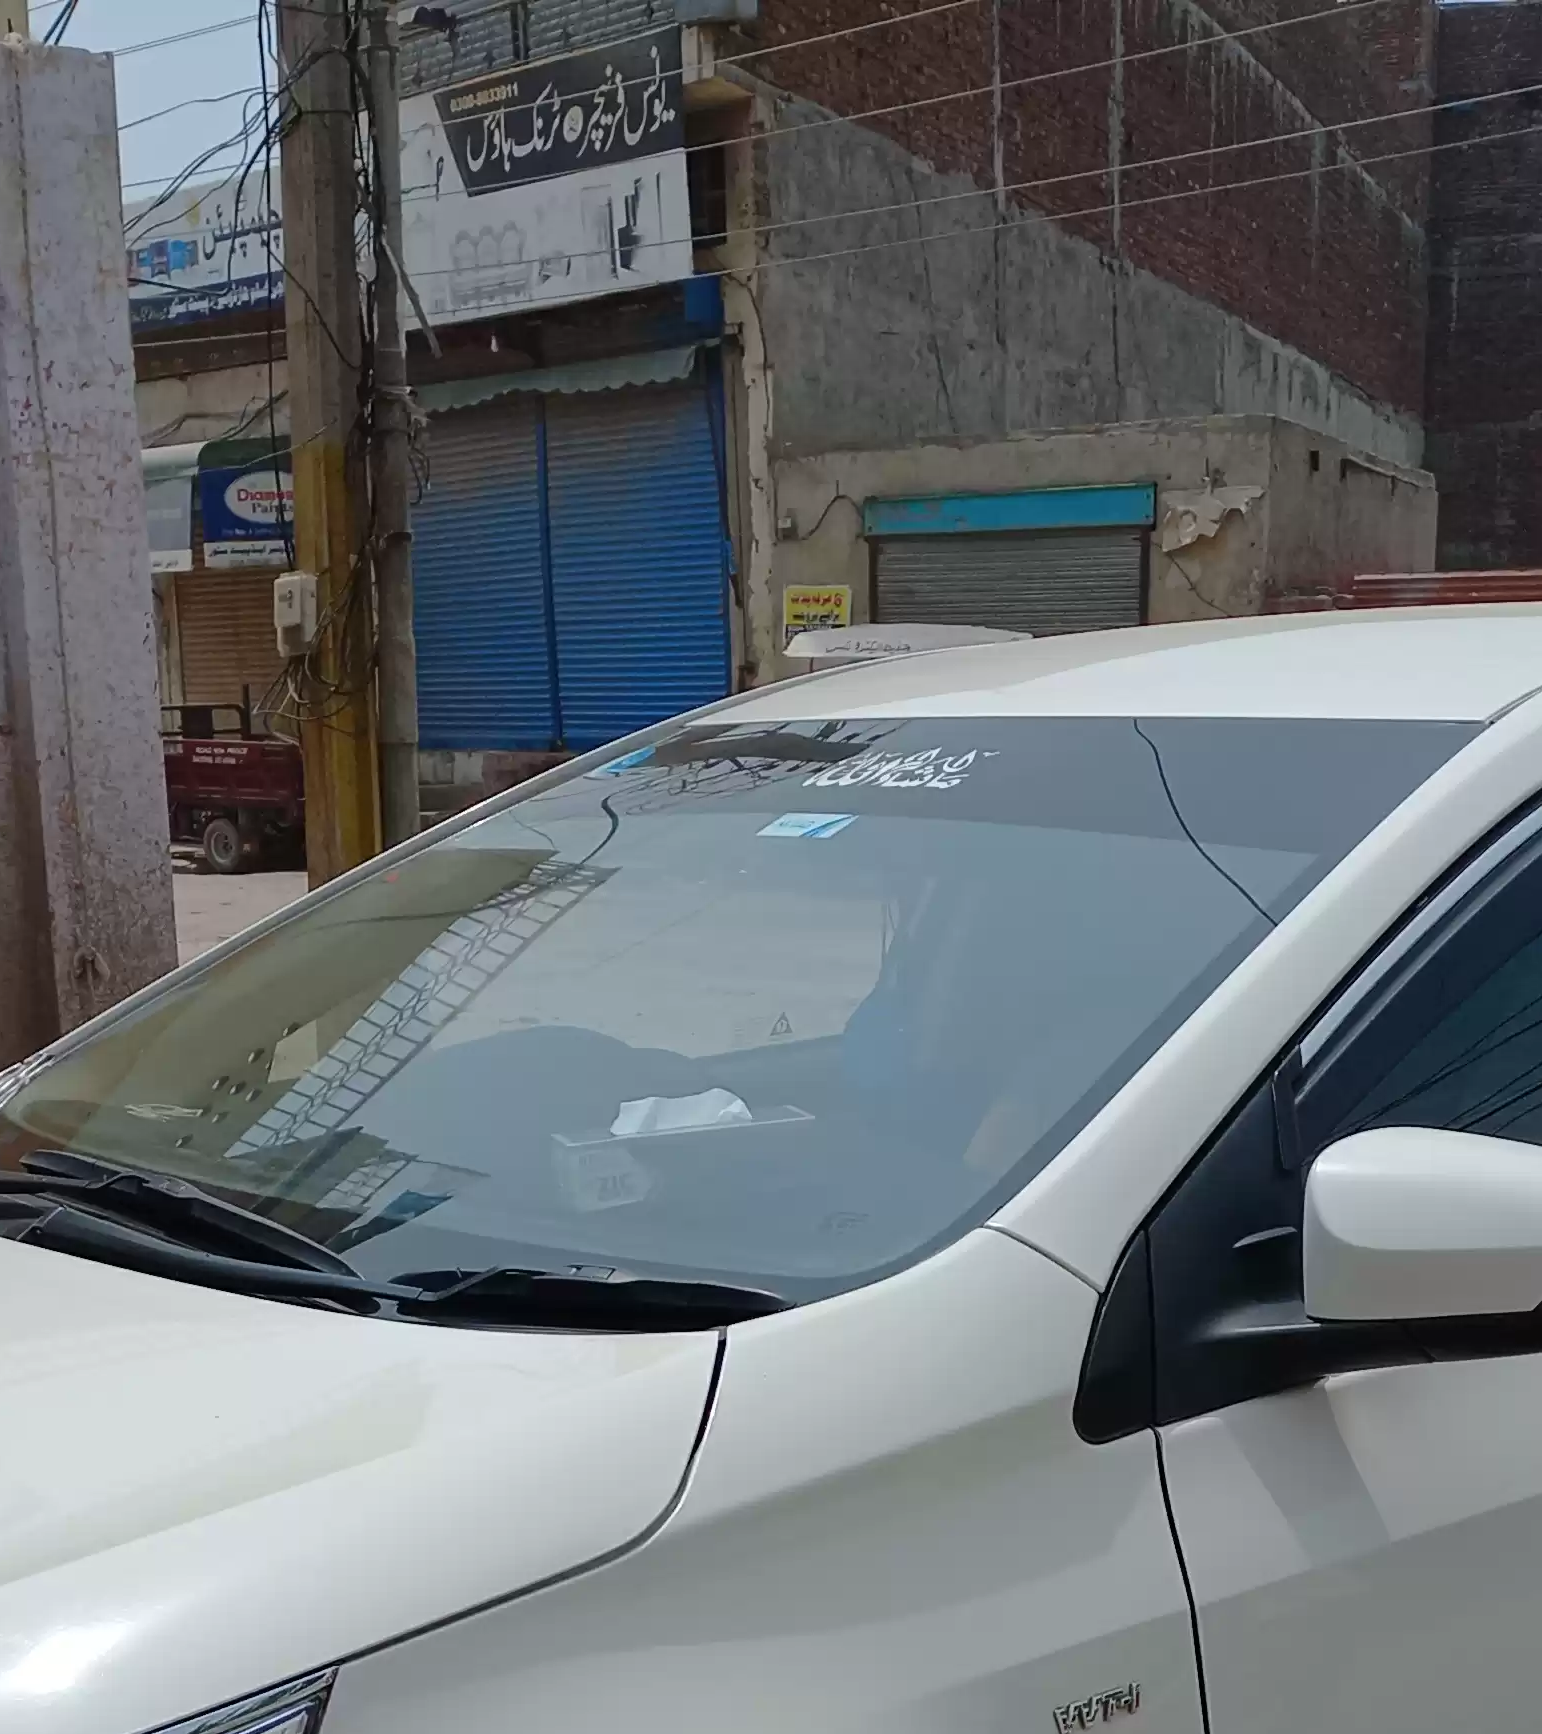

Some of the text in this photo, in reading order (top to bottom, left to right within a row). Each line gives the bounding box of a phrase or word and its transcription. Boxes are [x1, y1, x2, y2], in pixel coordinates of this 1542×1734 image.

[512, 81, 561, 158] ٹرنک
[577, 65, 625, 158] فرنیچر
[624, 46, 675, 145] یونس
[236, 489, 293, 502] Diamon
